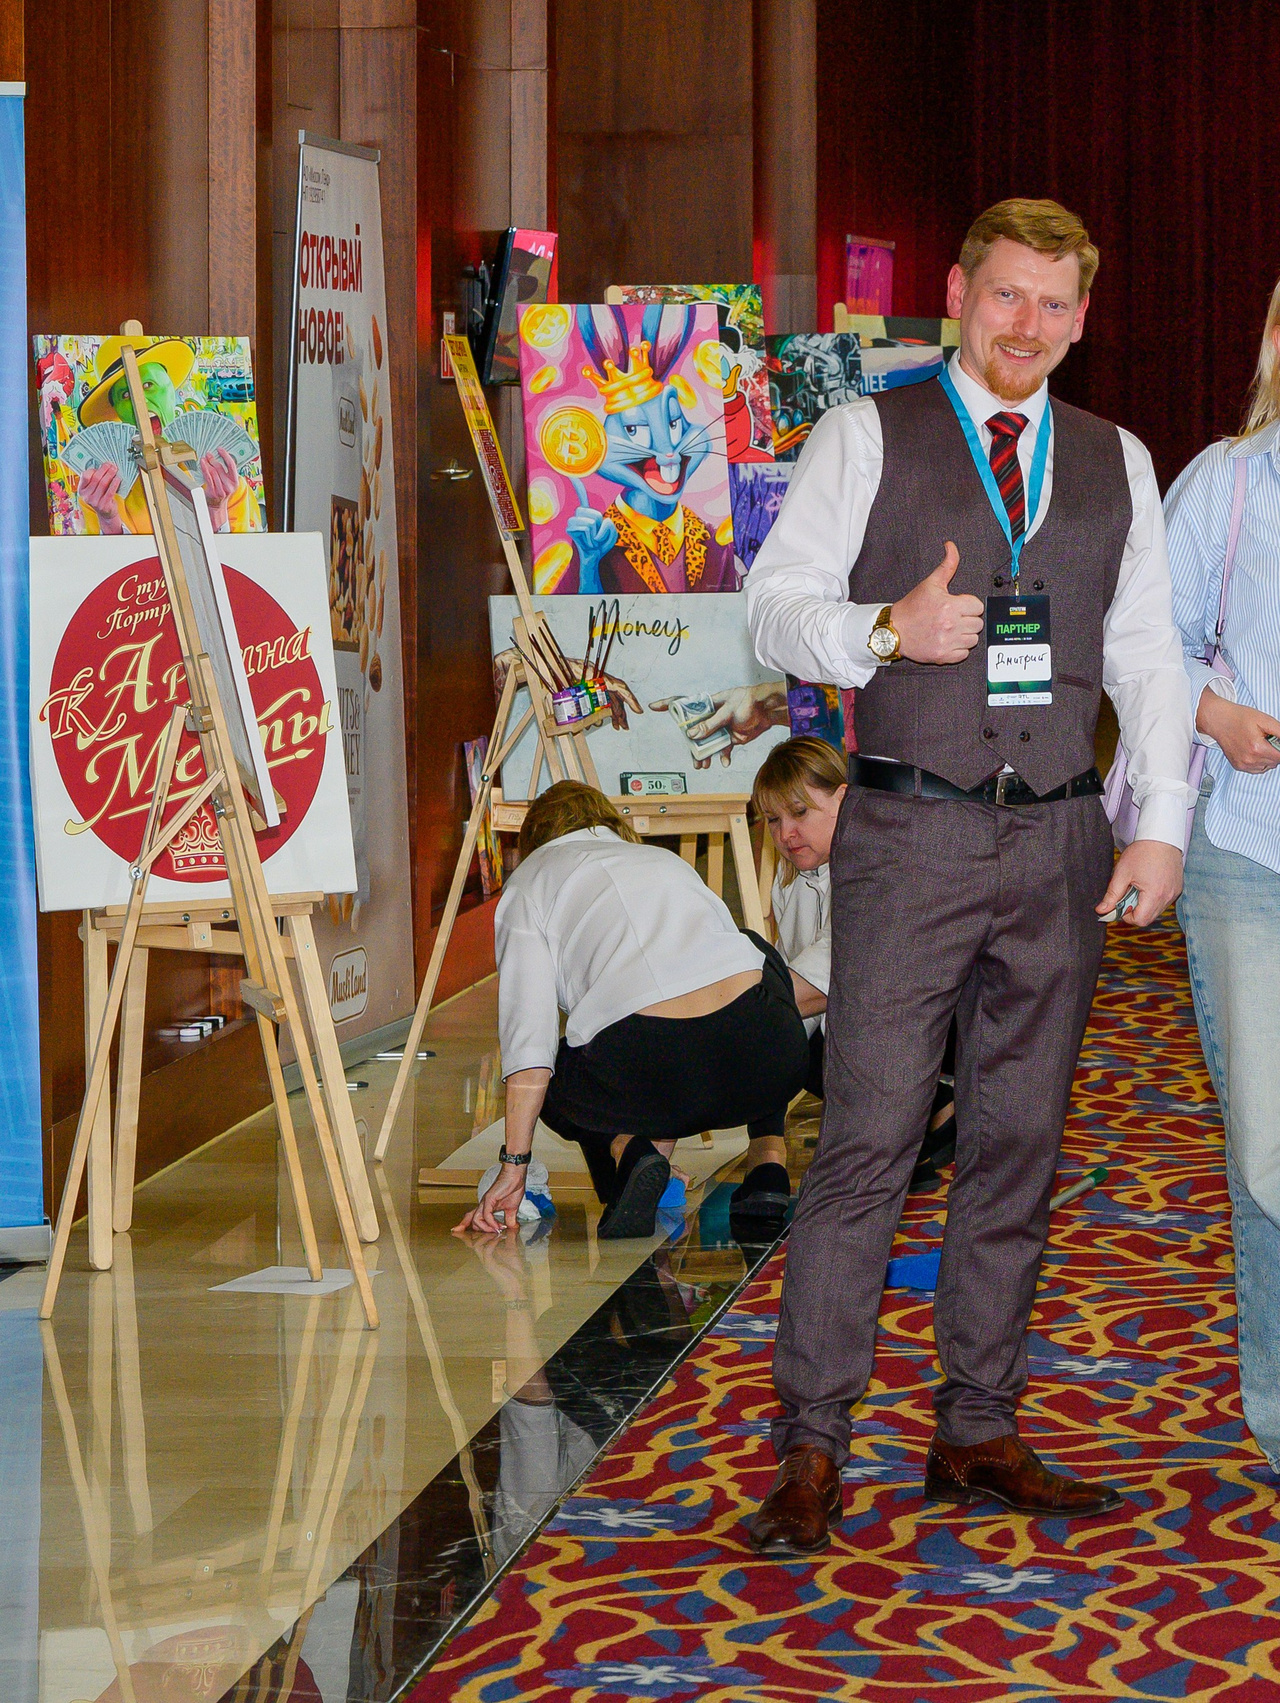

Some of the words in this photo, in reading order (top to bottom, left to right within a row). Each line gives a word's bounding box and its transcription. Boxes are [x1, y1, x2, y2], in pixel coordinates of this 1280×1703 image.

[300, 223, 362, 293] ОТКРЫВАЙ
[298, 307, 344, 365] НОВОЕ!
[97, 602, 171, 639] Портр
[589, 598, 690, 656] Money
[996, 623, 1041, 634] ПАРТНЕР
[995, 651, 1048, 670] Дмитрий
[64, 688, 334, 835] Меты
